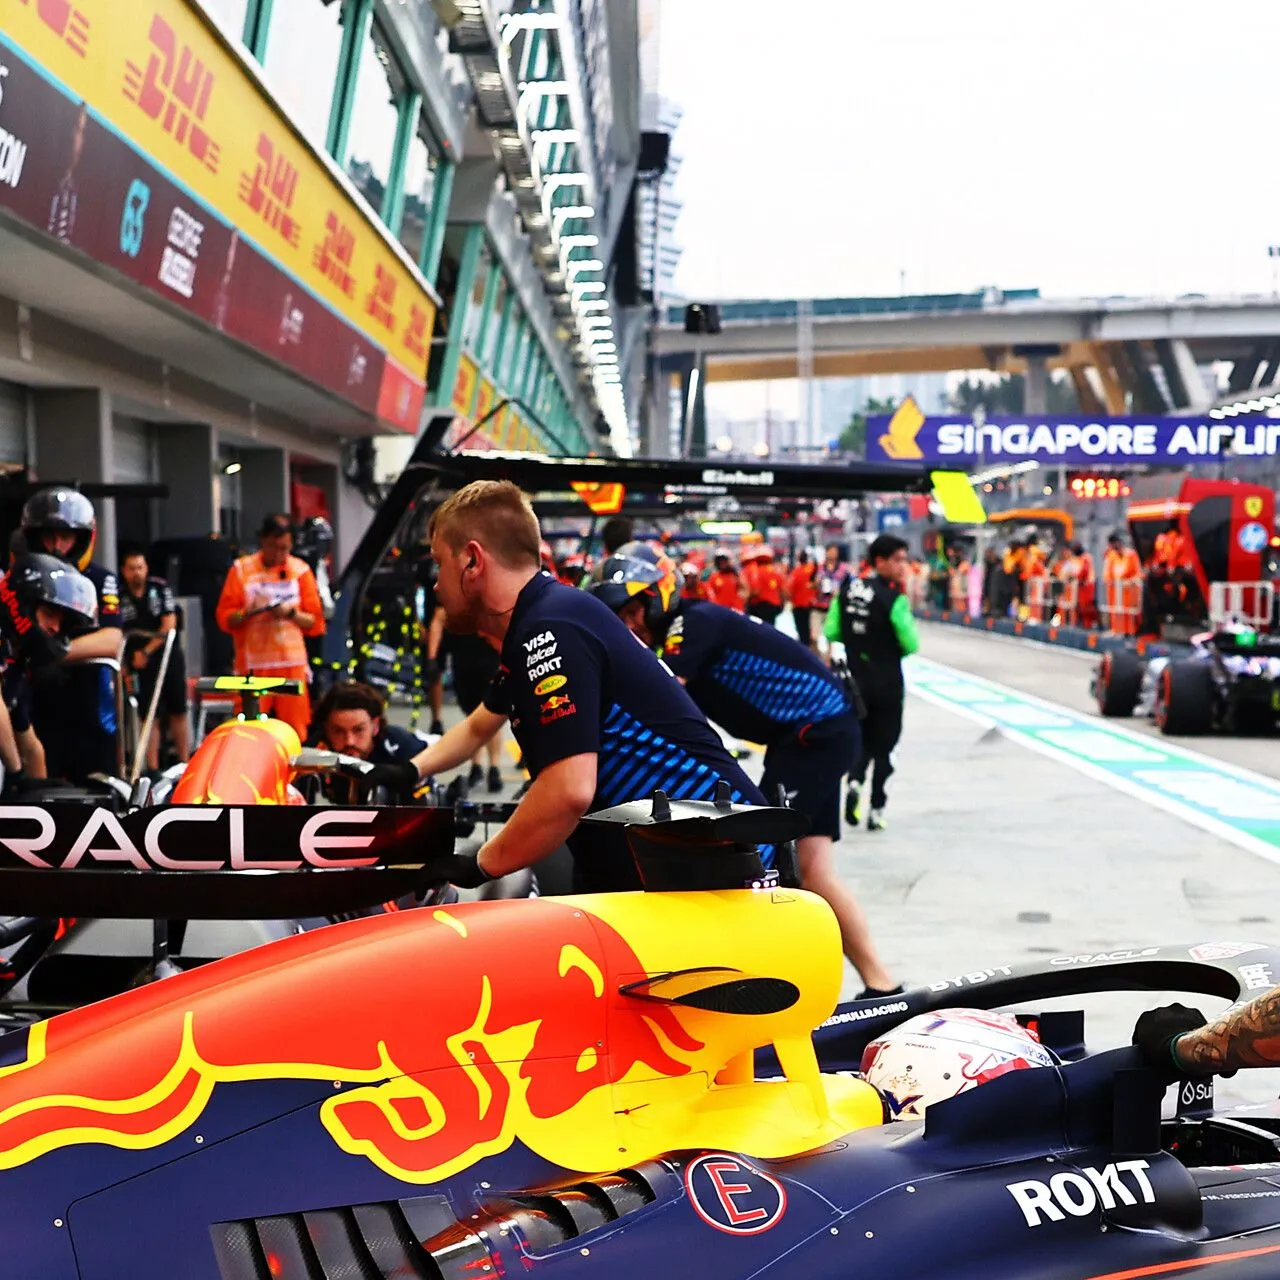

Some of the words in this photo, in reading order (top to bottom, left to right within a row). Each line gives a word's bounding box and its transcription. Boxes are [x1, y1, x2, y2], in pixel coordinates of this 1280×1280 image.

[937, 423, 1157, 456] SINGAPORE
[523, 631, 556, 652] VISA
[528, 656, 563, 682] ROKT
[1050, 948, 1160, 966] ORACLE
[929, 964, 1014, 993] BYBIT
[1196, 1082, 1214, 1100] Sui
[1006, 1158, 1159, 1229] ROKT
